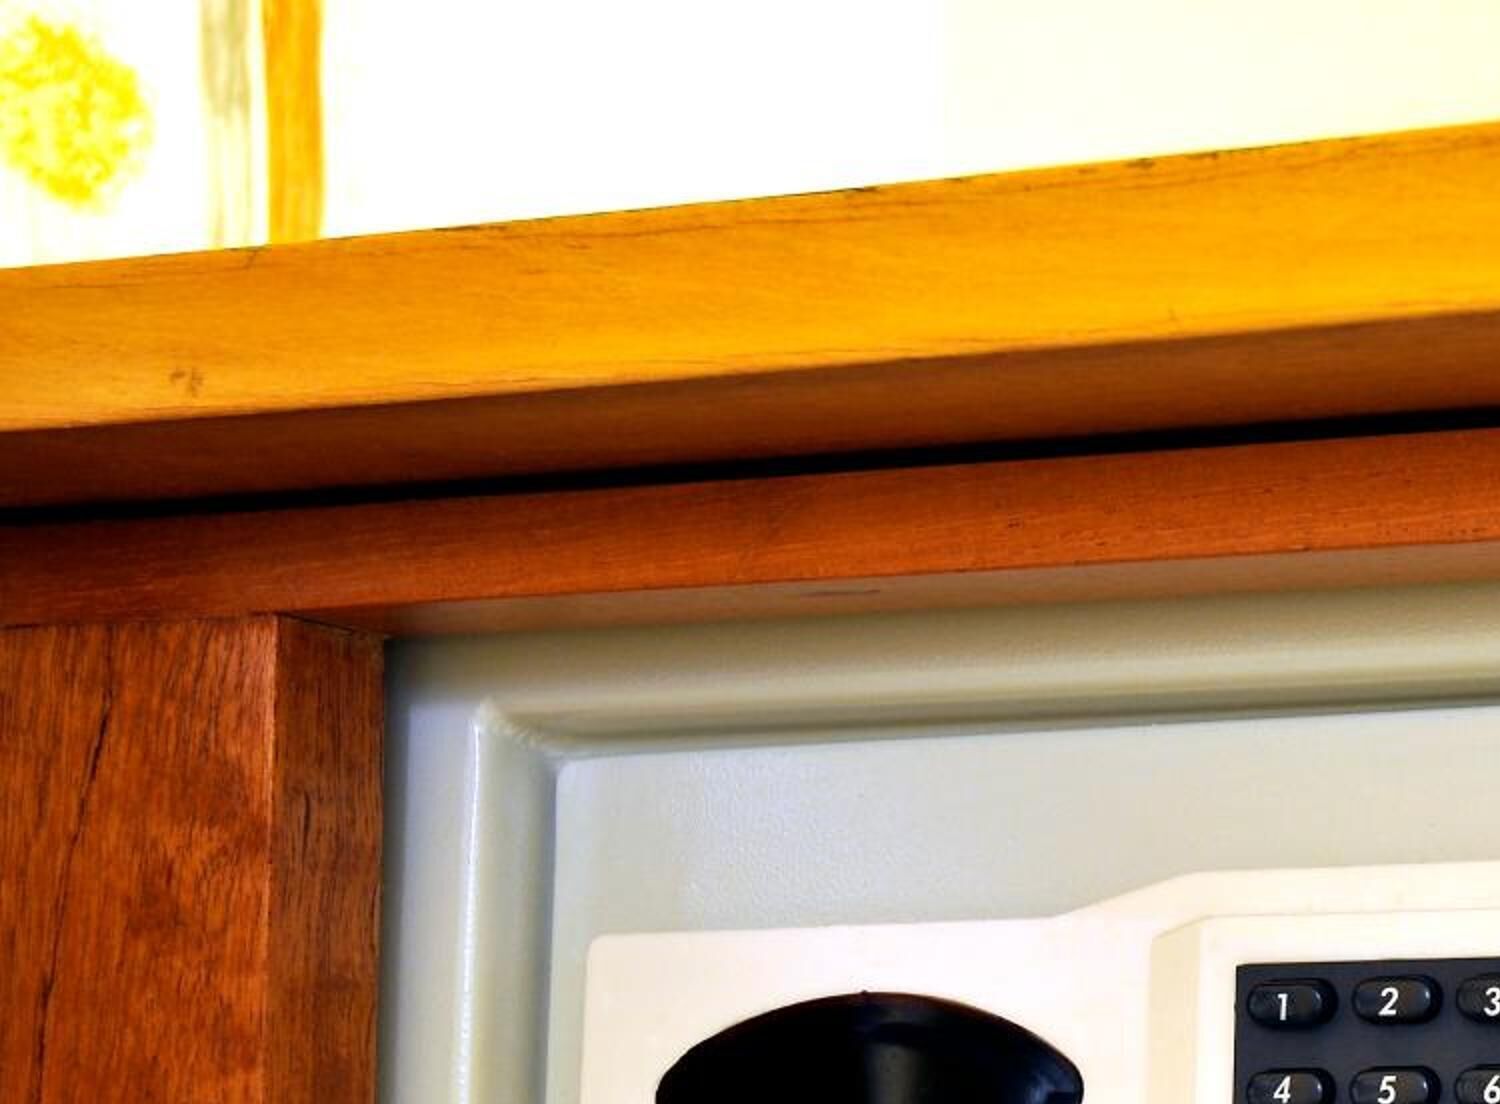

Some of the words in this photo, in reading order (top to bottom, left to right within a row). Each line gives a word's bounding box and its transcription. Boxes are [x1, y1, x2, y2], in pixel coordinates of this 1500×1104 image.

[1277, 993, 1288, 1020] 1
[1378, 988, 1399, 1017] 2
[1273, 1077, 1291, 1104] 4
[1378, 1077, 1397, 1104] 5
